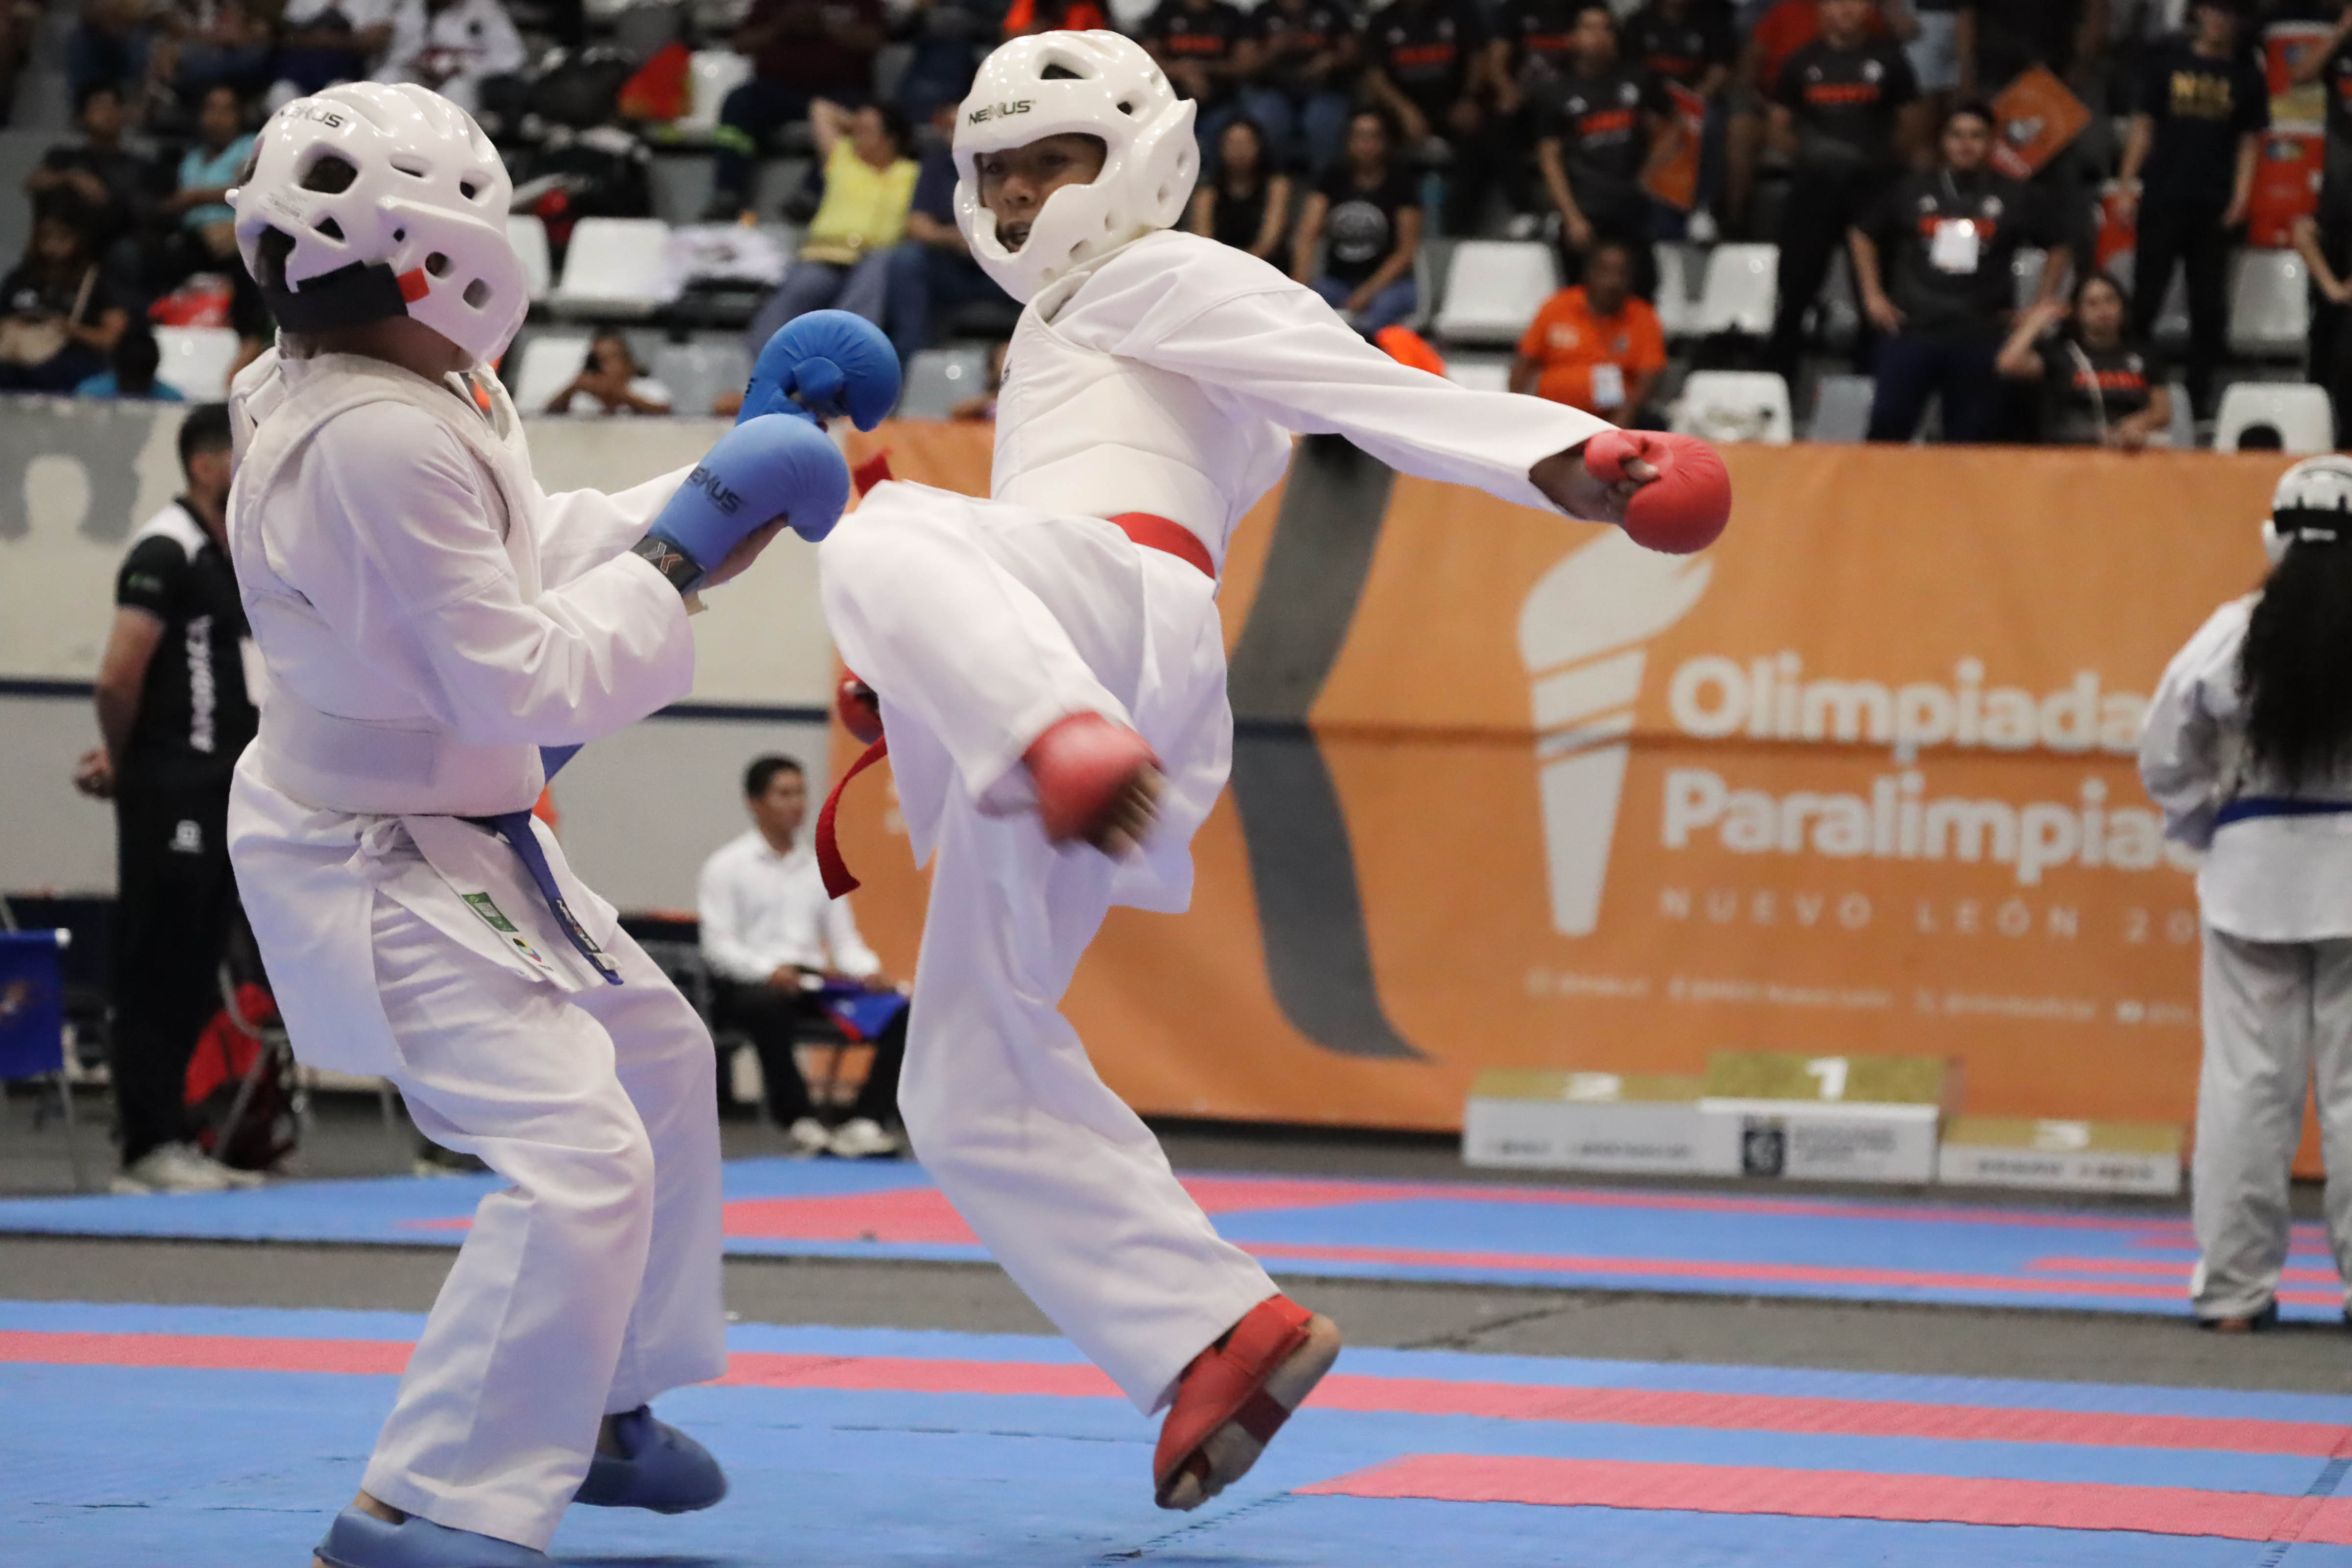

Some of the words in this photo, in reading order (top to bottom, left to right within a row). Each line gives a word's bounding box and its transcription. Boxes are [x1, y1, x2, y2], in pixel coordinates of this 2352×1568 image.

[969, 100, 1031, 126] NEXUS
[1669, 649, 2150, 765] Olimpiada
[1660, 888, 1873, 930] NUEVO
[1914, 895, 2079, 939] LEÓN
[1806, 1055, 1848, 1102] 1
